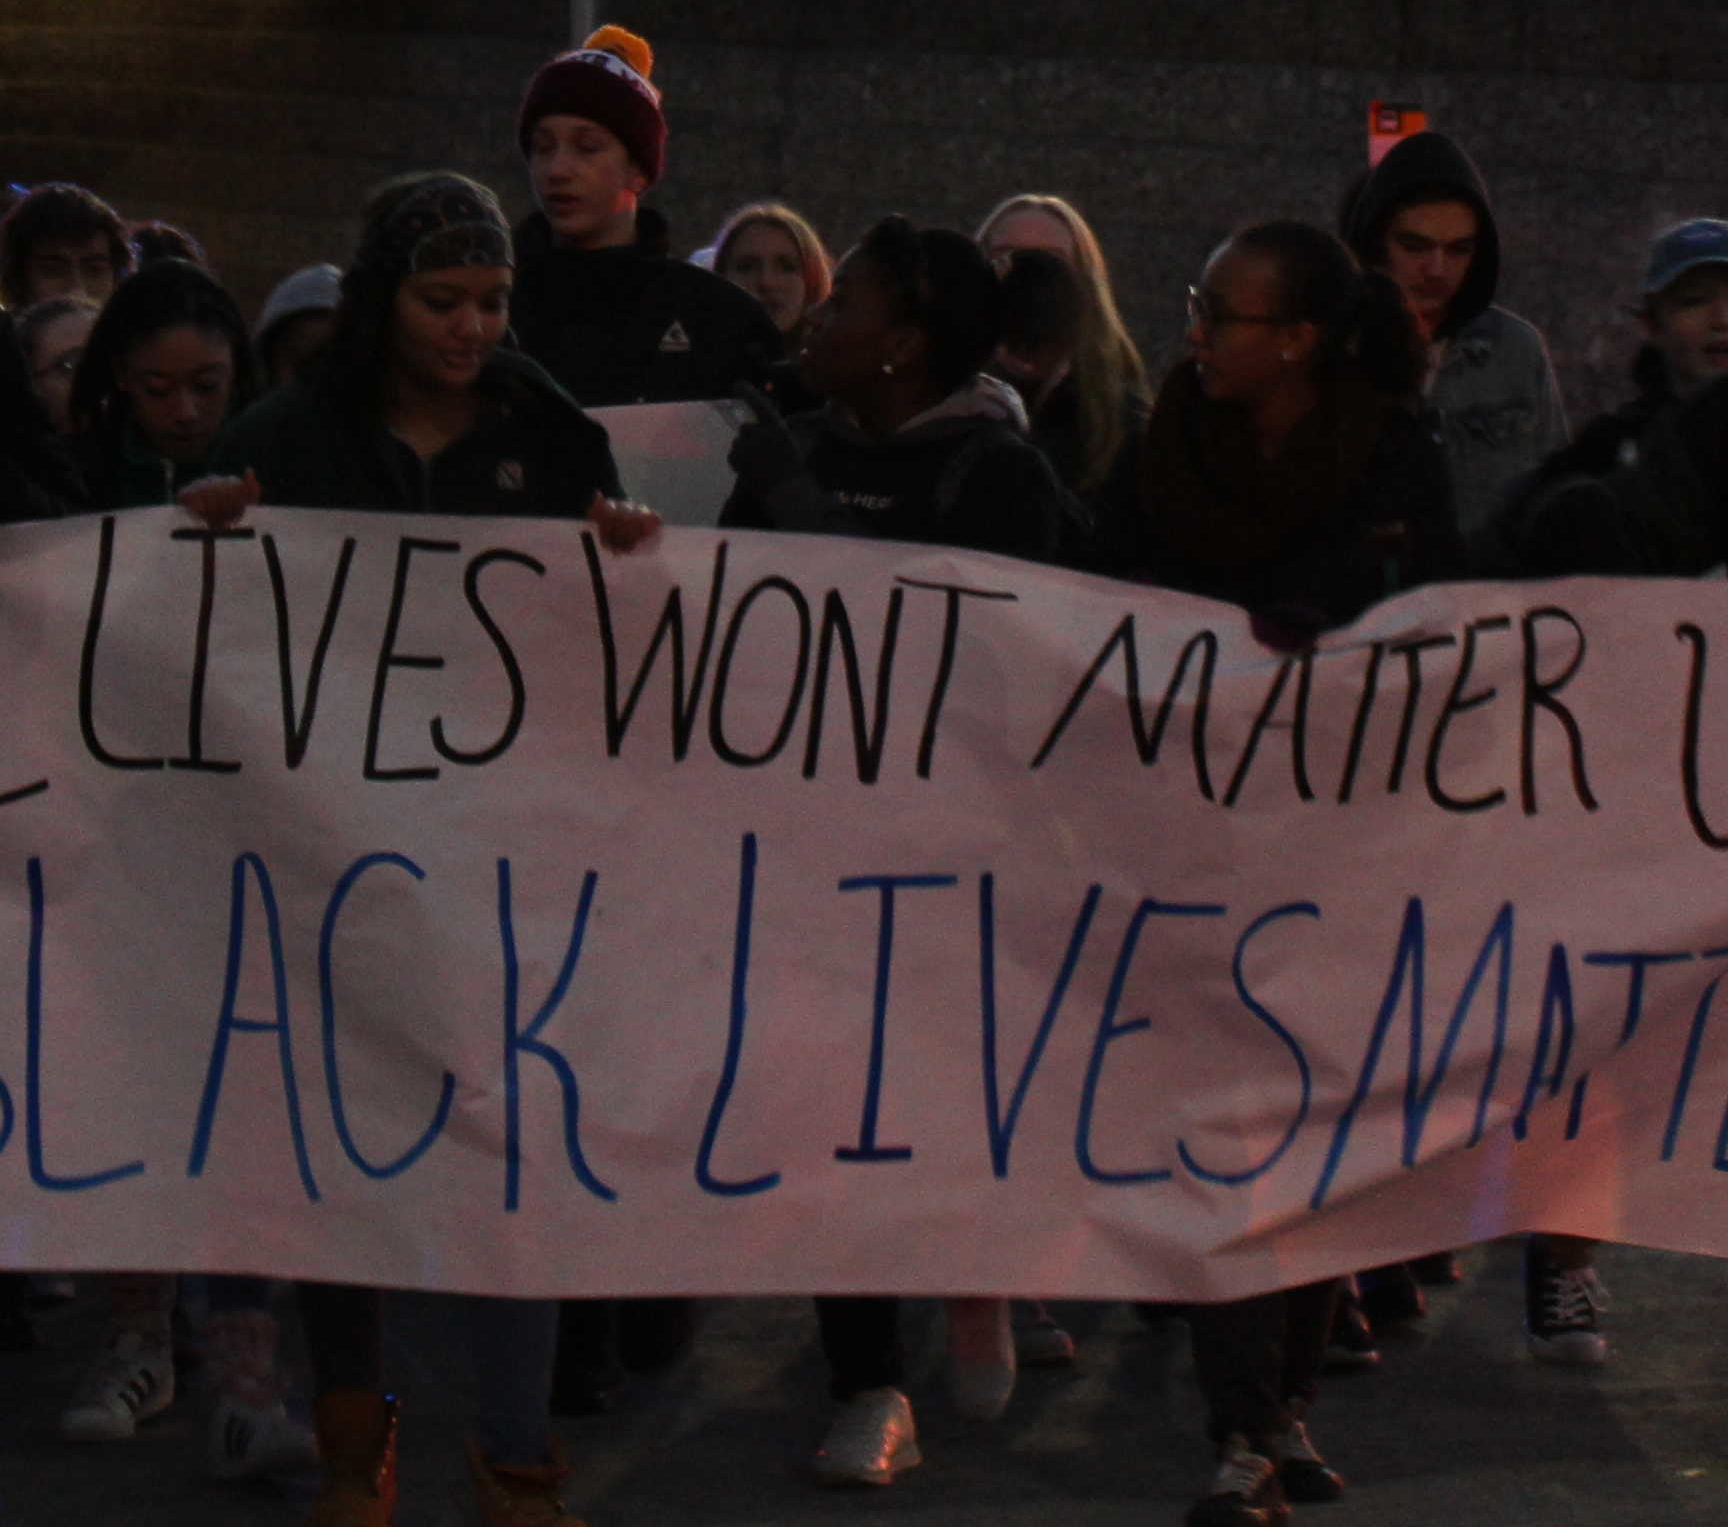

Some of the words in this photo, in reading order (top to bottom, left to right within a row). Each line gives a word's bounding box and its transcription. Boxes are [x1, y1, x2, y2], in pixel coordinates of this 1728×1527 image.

[78, 516, 547, 780] LIVES
[581, 530, 1019, 784] WONT
[1029, 606, 1598, 816] MATTER
[693, 831, 1321, 1197] LIVES
